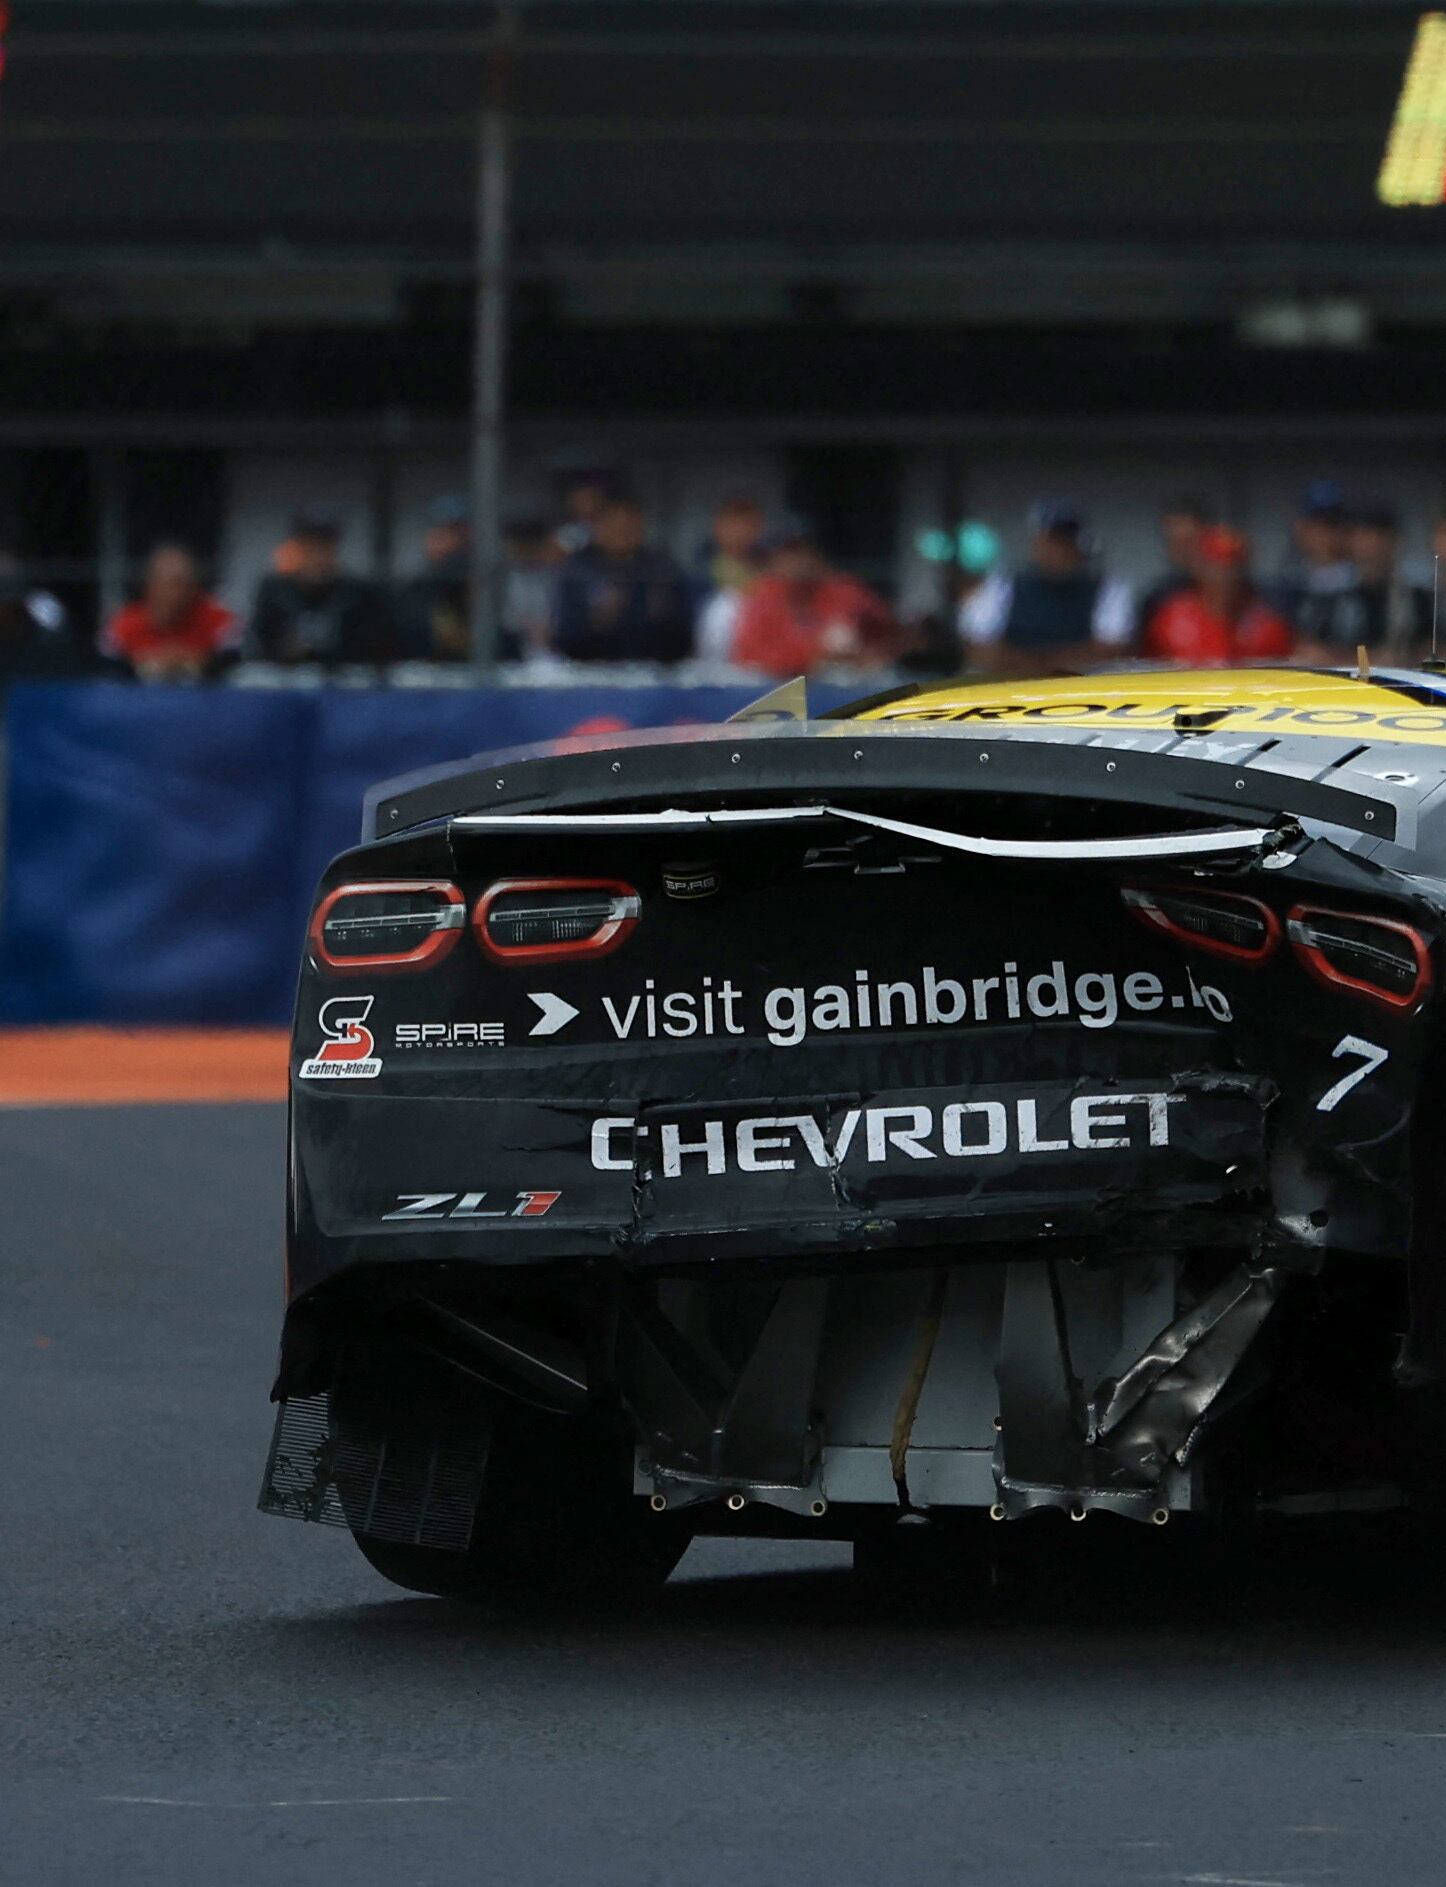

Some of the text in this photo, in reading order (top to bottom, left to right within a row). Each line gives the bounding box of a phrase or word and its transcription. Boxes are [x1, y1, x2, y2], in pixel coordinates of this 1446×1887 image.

[602, 960, 1234, 1047] visit gainbridge.io
[395, 1021, 505, 1042] SPIRE
[305, 1062, 377, 1076] safety-kleen
[1316, 1034, 1389, 1112] 7
[590, 1092, 1188, 1180] CHEVROLET
[380, 1190, 563, 1222] ZL1
